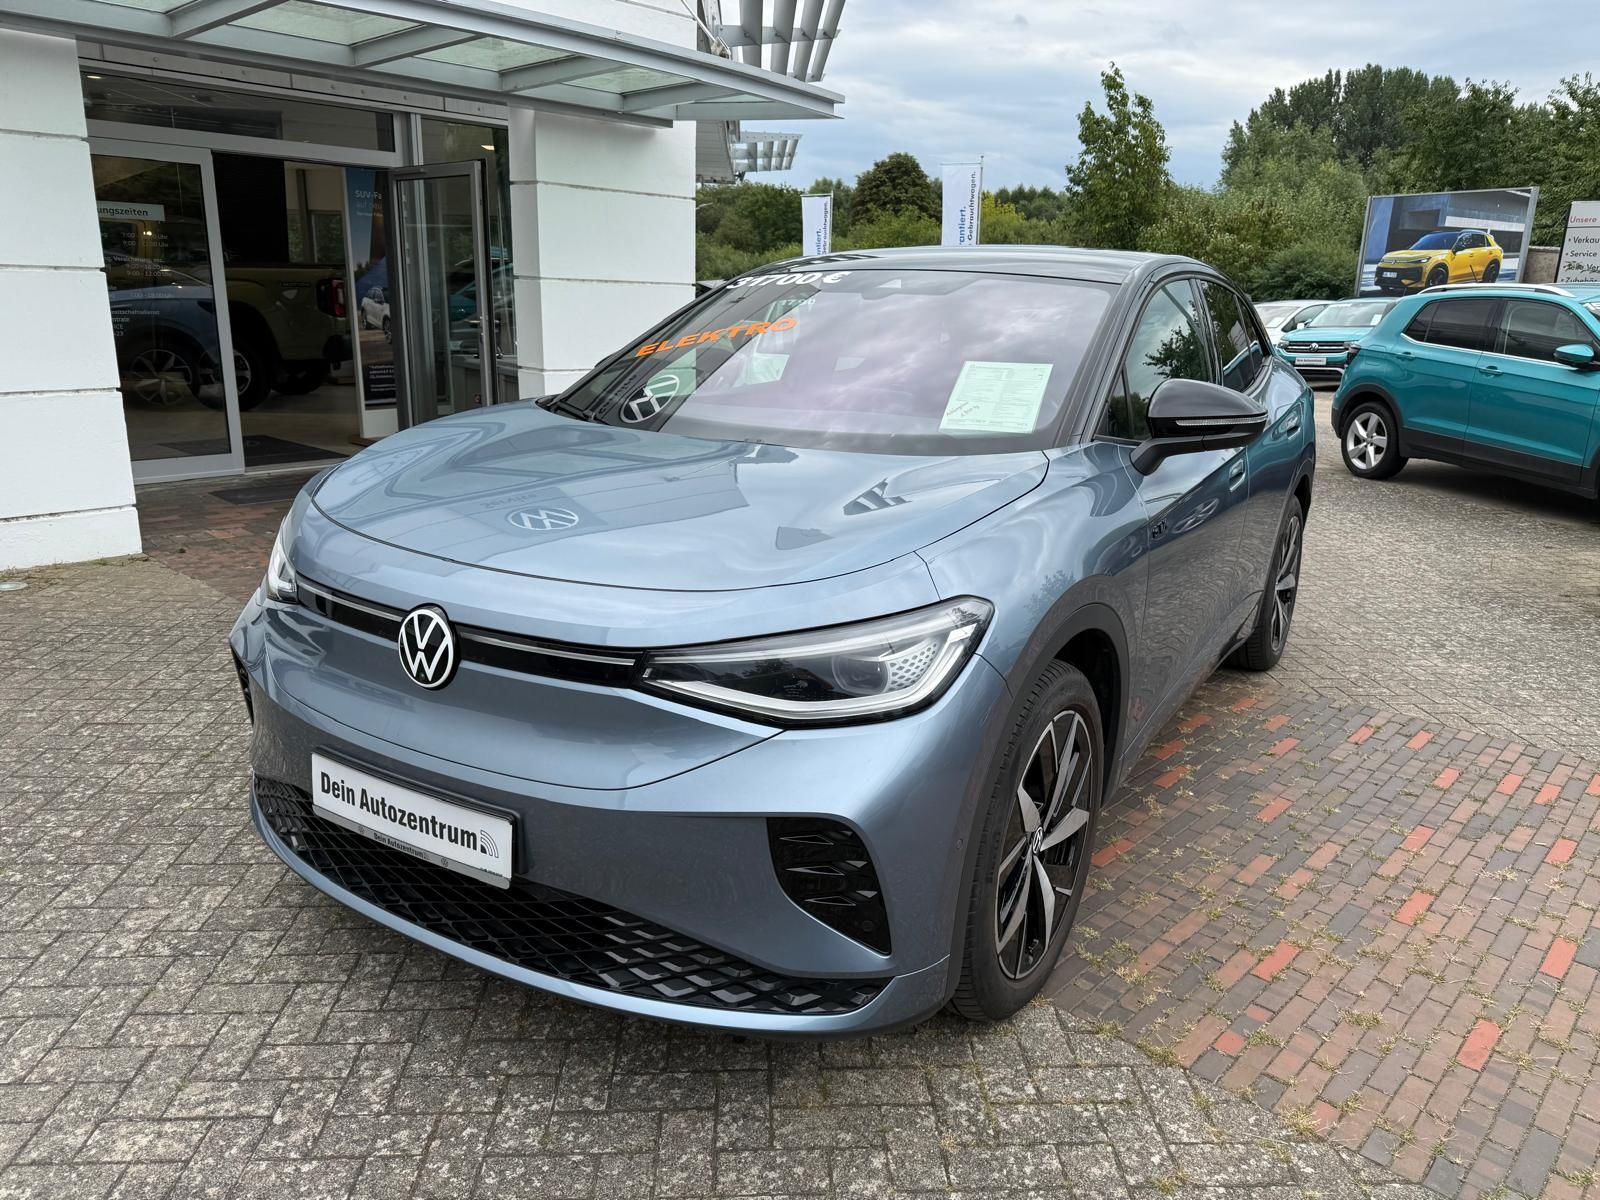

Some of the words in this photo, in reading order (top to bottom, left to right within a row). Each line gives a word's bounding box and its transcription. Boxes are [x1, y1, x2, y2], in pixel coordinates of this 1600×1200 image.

[967, 171, 977, 242] Gebrauchtwagen.
[1569, 216, 1597, 224] Unsere
[726, 273, 823, 289] 31700
[634, 317, 799, 358] ELEKTRO
[398, 608, 454, 688] VW
[320, 771, 356, 806] Dein
[359, 788, 478, 851] Autozentrum
